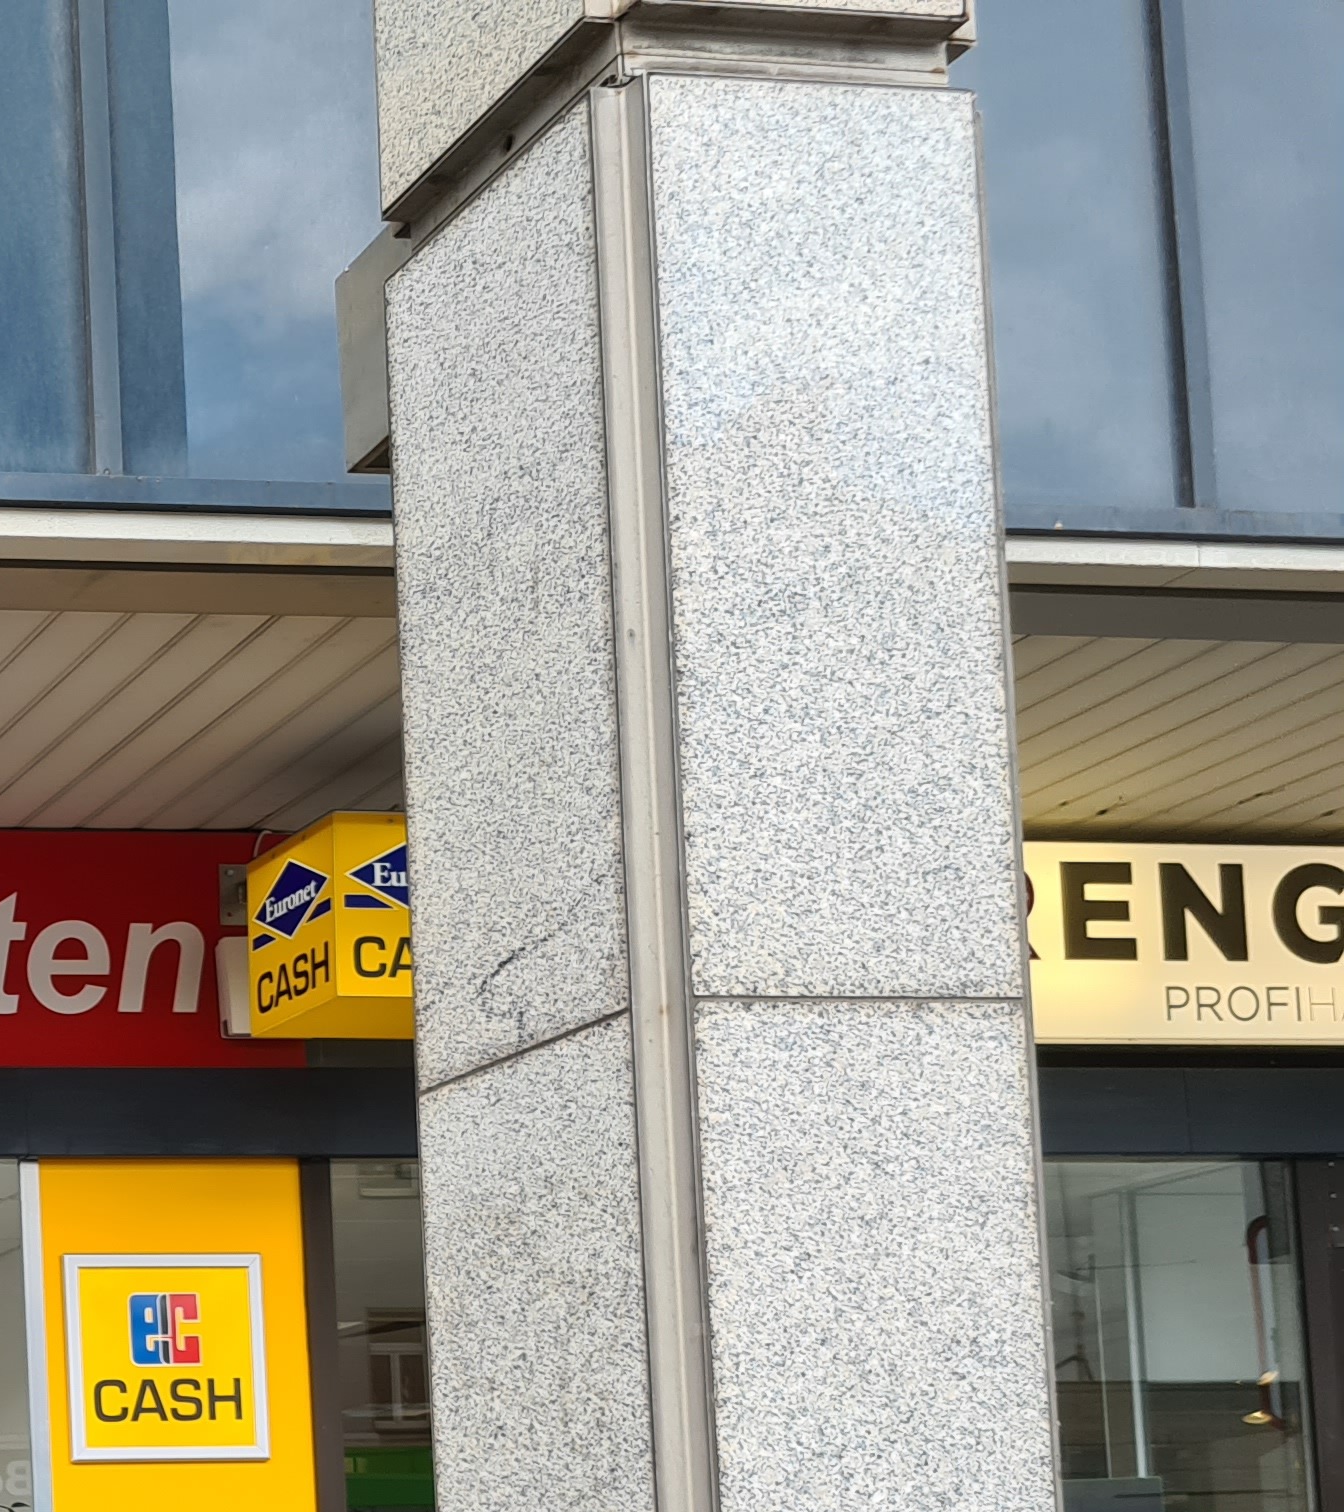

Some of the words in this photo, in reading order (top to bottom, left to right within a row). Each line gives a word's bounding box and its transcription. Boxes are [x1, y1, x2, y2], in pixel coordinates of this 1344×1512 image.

[264, 880, 319, 923] Euronet
[1024, 860, 1344, 965] ENG
[256, 941, 330, 1014] CASH
[92, 1377, 244, 1423] CASH
